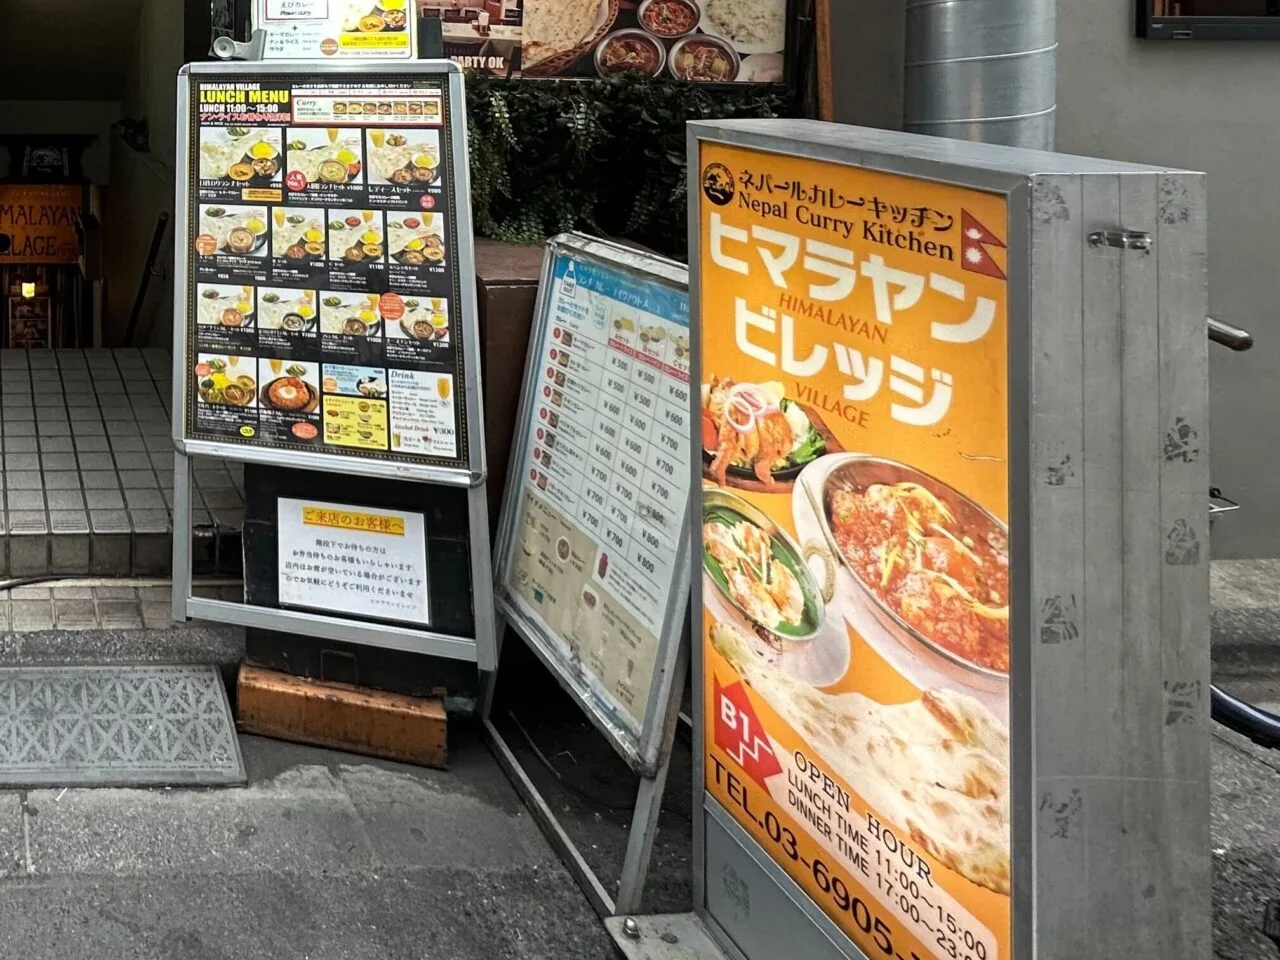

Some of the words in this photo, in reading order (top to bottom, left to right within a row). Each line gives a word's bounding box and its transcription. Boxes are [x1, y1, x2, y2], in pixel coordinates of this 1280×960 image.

[484, 55, 504, 69] OK
[200, 90, 245, 103] LUNCH
[249, 90, 289, 103] MENU
[200, 103, 225, 113] LUNCH
[738, 169, 954, 232] ネパールカレーキッチン
[738, 191, 788, 219] Nepal
[795, 205, 854, 239] Curry
[863, 221, 954, 261] Kitchen
[709, 211, 997, 344] ヒマラヤン
[779, 292, 888, 344] HIMALAYAN
[391, 370, 415, 380] Drink
[734, 296, 953, 427] ビレッジ
[633, 391, 651, 408] ¥500
[665, 409, 683, 427] ¥600
[796, 382, 869, 429] VILLAGE
[433, 427, 455, 435] ¥300
[661, 433, 678, 451] ¥700
[625, 437, 642, 454] ¥600
[656, 456, 674, 475] ¥700
[590, 465, 608, 483] ¥700
[616, 483, 632, 501] ¥700
[620, 460, 637, 478] ¥600
[652, 479, 669, 500] ¥700
[304, 508, 405, 532] ご来店のお客様へ
[582, 510, 599, 528] ¥700
[606, 528, 623, 548] ¥700
[637, 552, 655, 573] ¥800
[587, 488, 603, 505] ¥700
[611, 505, 628, 524] ¥700
[642, 528, 660, 549] ¥800
[315, 538, 387, 555] 階段下でお待ちの方は
[720, 694, 749, 742] B1
[788, 768, 832, 816] LUNCH
[835, 813, 868, 855] TIME
[794, 751, 851, 813] OPEN
[867, 812, 935, 888] HOUR
[710, 752, 921, 960] TEL.03-6905-
[788, 789, 833, 843] DINNER
[835, 836, 869, 878] TIME
[876, 873, 975, 960] 17:00～23:
